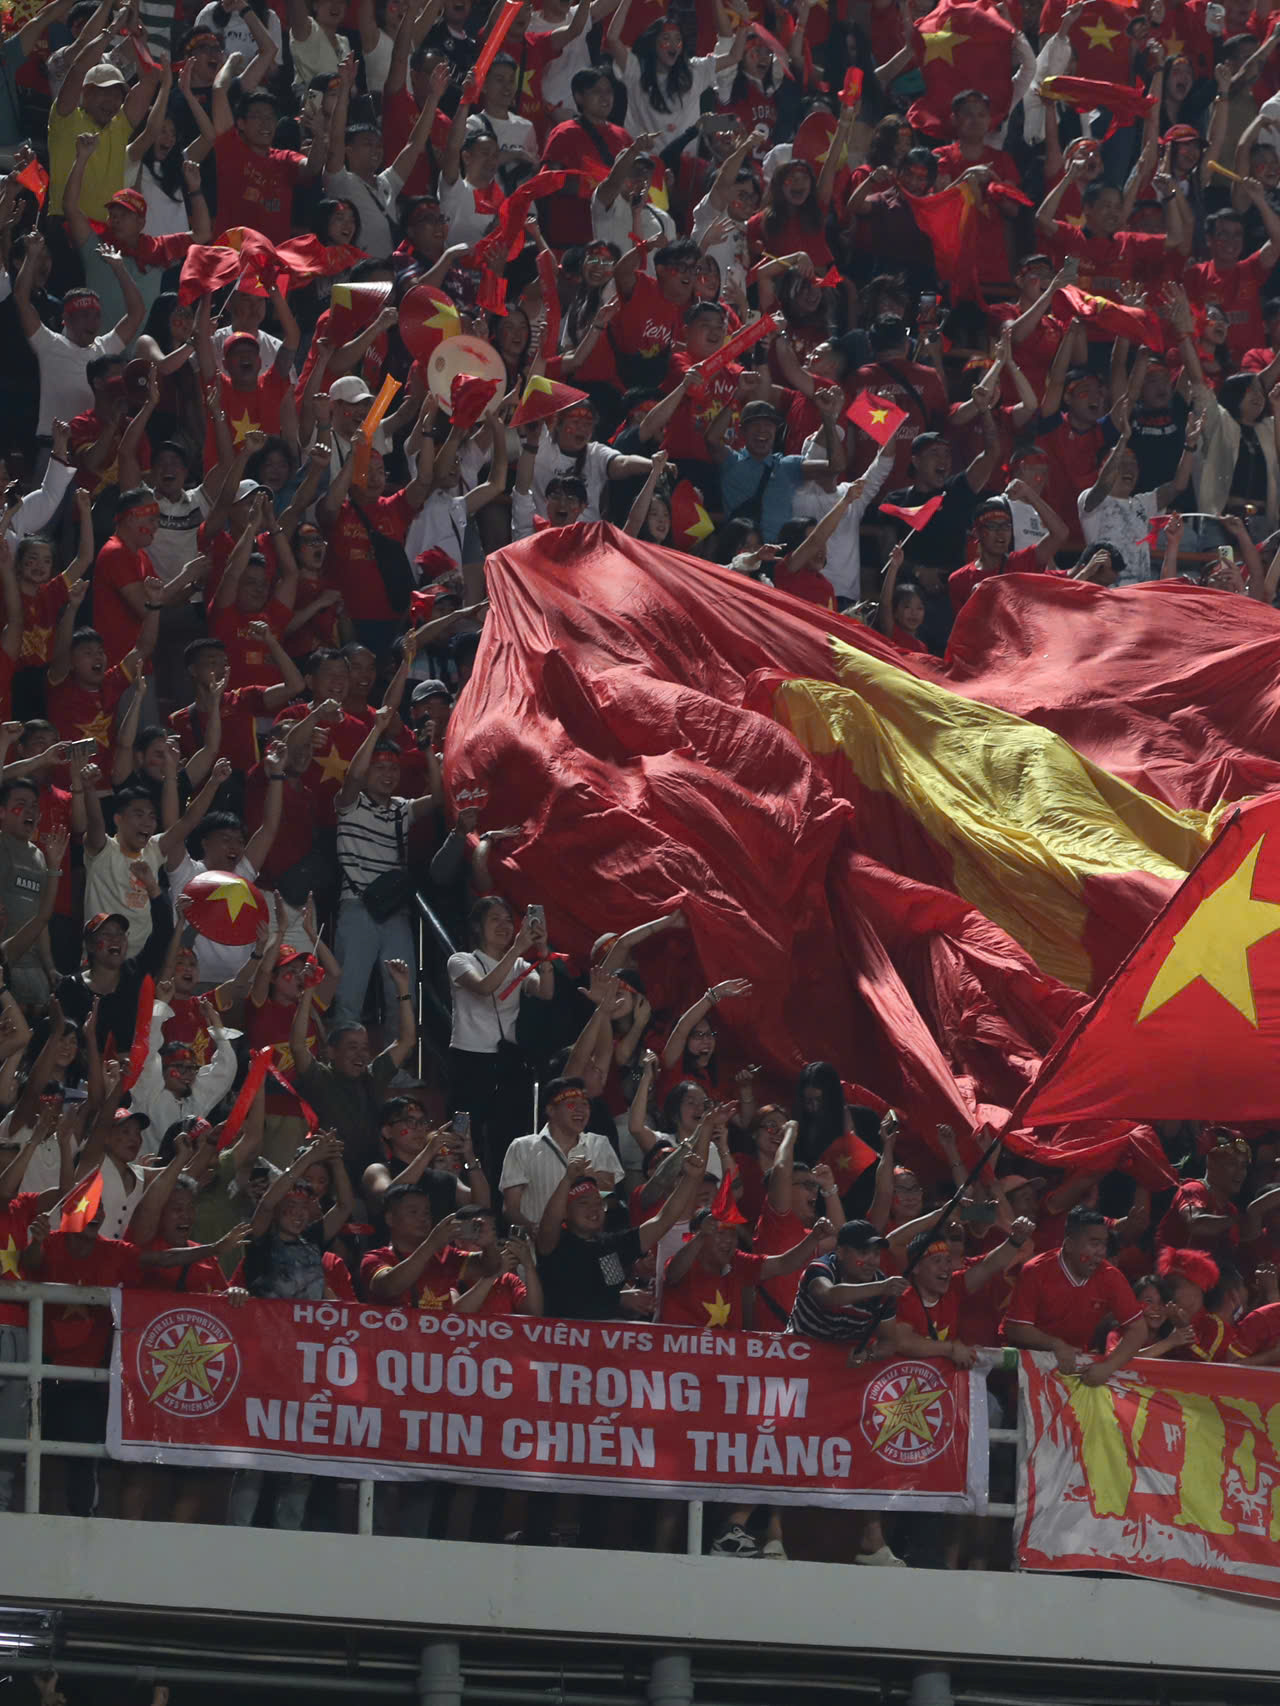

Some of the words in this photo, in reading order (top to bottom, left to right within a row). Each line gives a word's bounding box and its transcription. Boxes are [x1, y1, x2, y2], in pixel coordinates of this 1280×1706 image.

[293, 1303, 349, 1331] HỘI
[418, 1313, 514, 1342] ĐỘNG
[522, 1322, 591, 1347] VIÊN
[601, 1329, 653, 1352] VFS
[296, 1330, 360, 1387] TỔ
[376, 1341, 514, 1400] QUỐC
[529, 1360, 701, 1412] TRONG
[716, 1374, 809, 1418] TIM
[245, 1389, 382, 1449] NIỀM
[400, 1409, 483, 1457] TIN
[502, 1412, 656, 1468] CHIẾN
[687, 1418, 852, 1479] THẮNG
